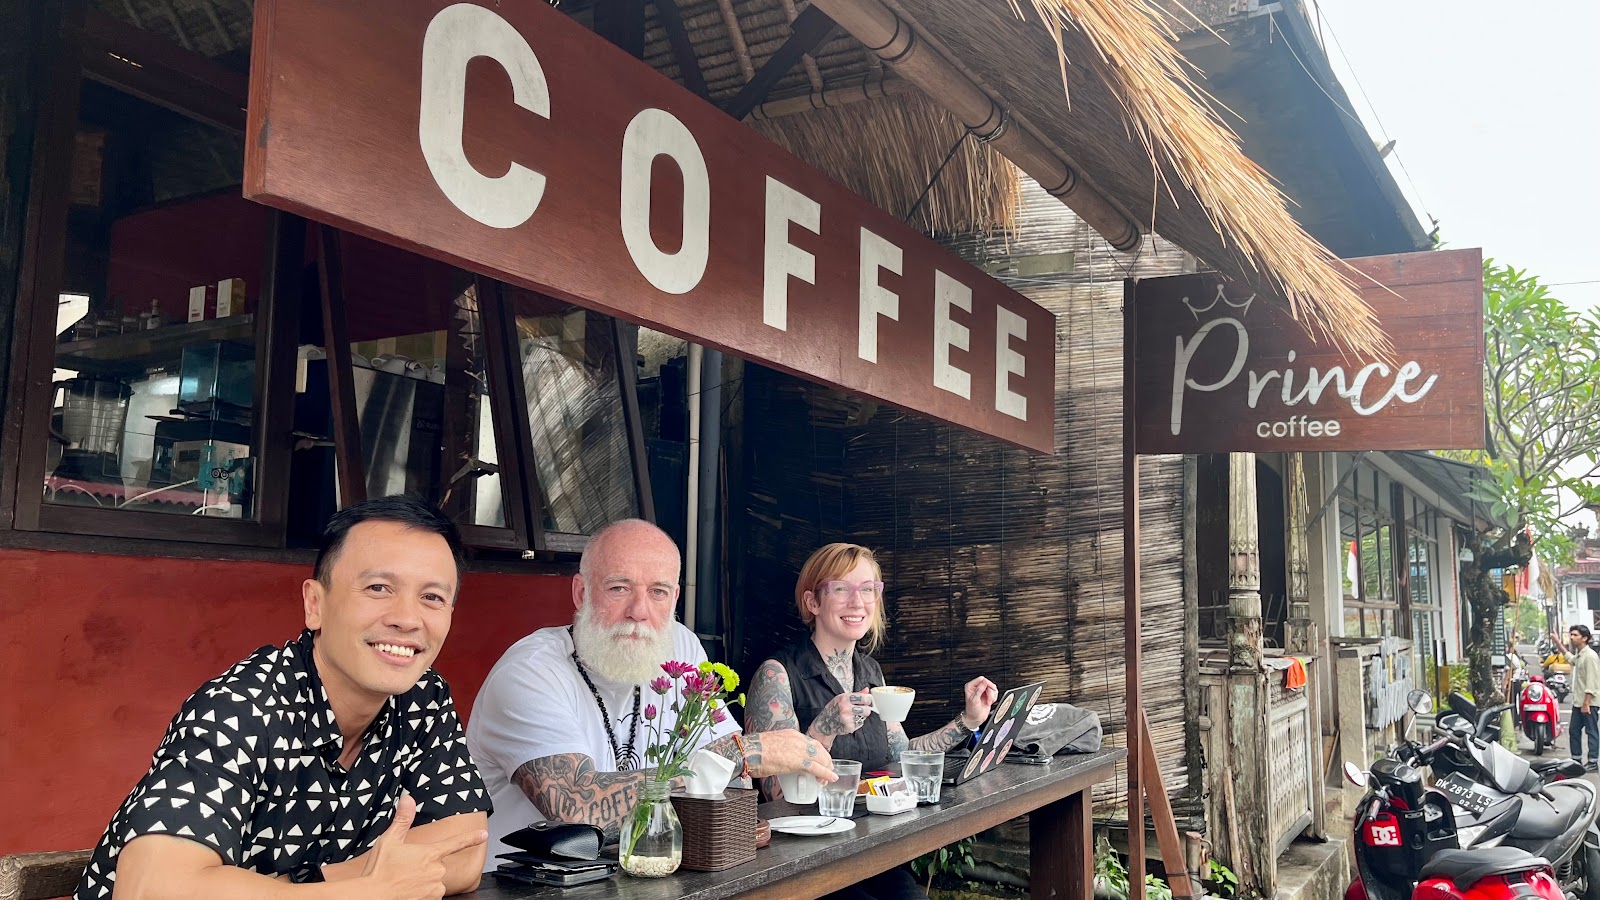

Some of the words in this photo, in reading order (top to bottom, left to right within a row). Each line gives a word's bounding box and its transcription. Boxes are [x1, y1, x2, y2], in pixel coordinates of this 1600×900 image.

[419, 2, 1028, 422] COFFEE
[1170, 317, 1439, 436] Prince
[1256, 415, 1341, 438] coffee
[1435, 778, 1450, 790] DK
[1449, 784, 1474, 799] 2873
[1476, 794, 1492, 806] LS
